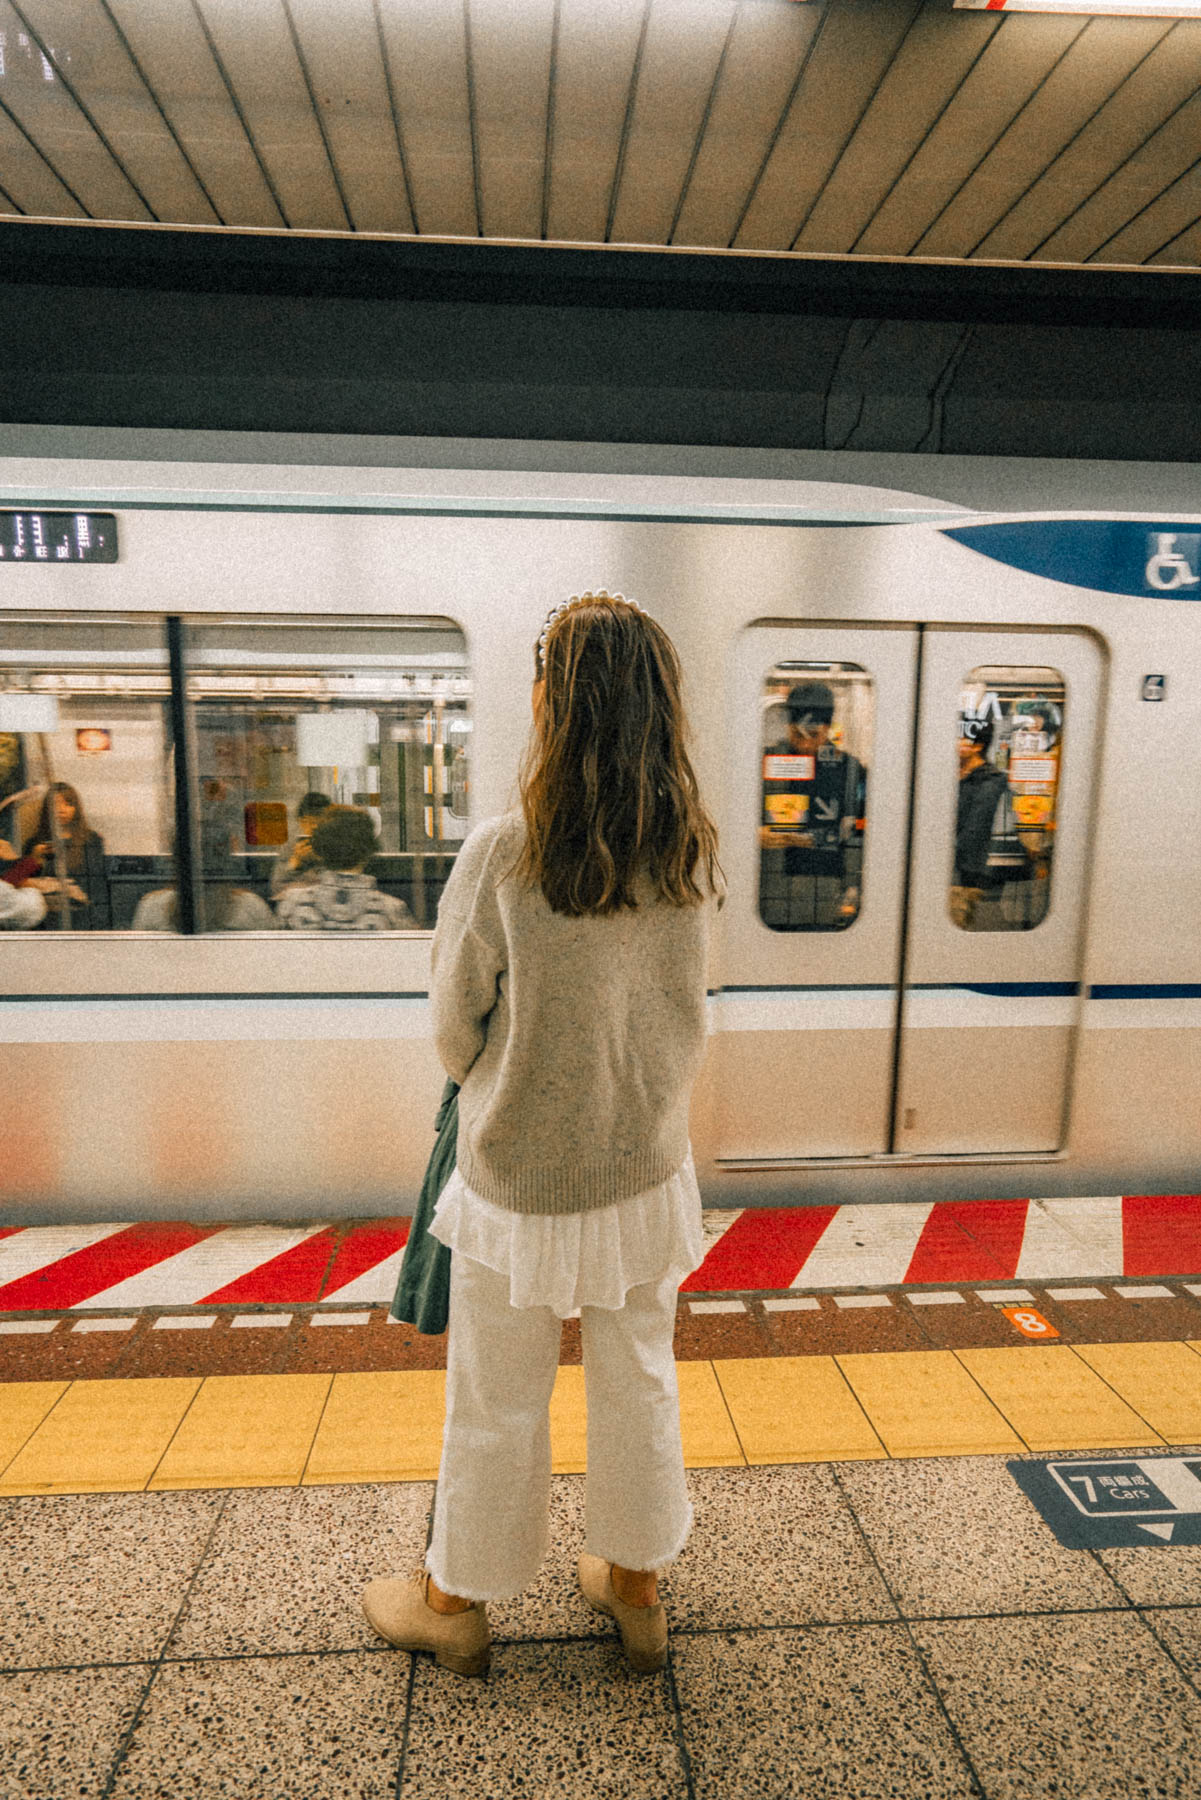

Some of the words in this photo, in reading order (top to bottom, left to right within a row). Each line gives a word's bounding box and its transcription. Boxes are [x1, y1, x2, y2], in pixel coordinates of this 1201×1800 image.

[1014, 1312, 1047, 1333] 8
[1068, 1475, 1098, 1503] 7
[1109, 1487, 1150, 1500] Cars
